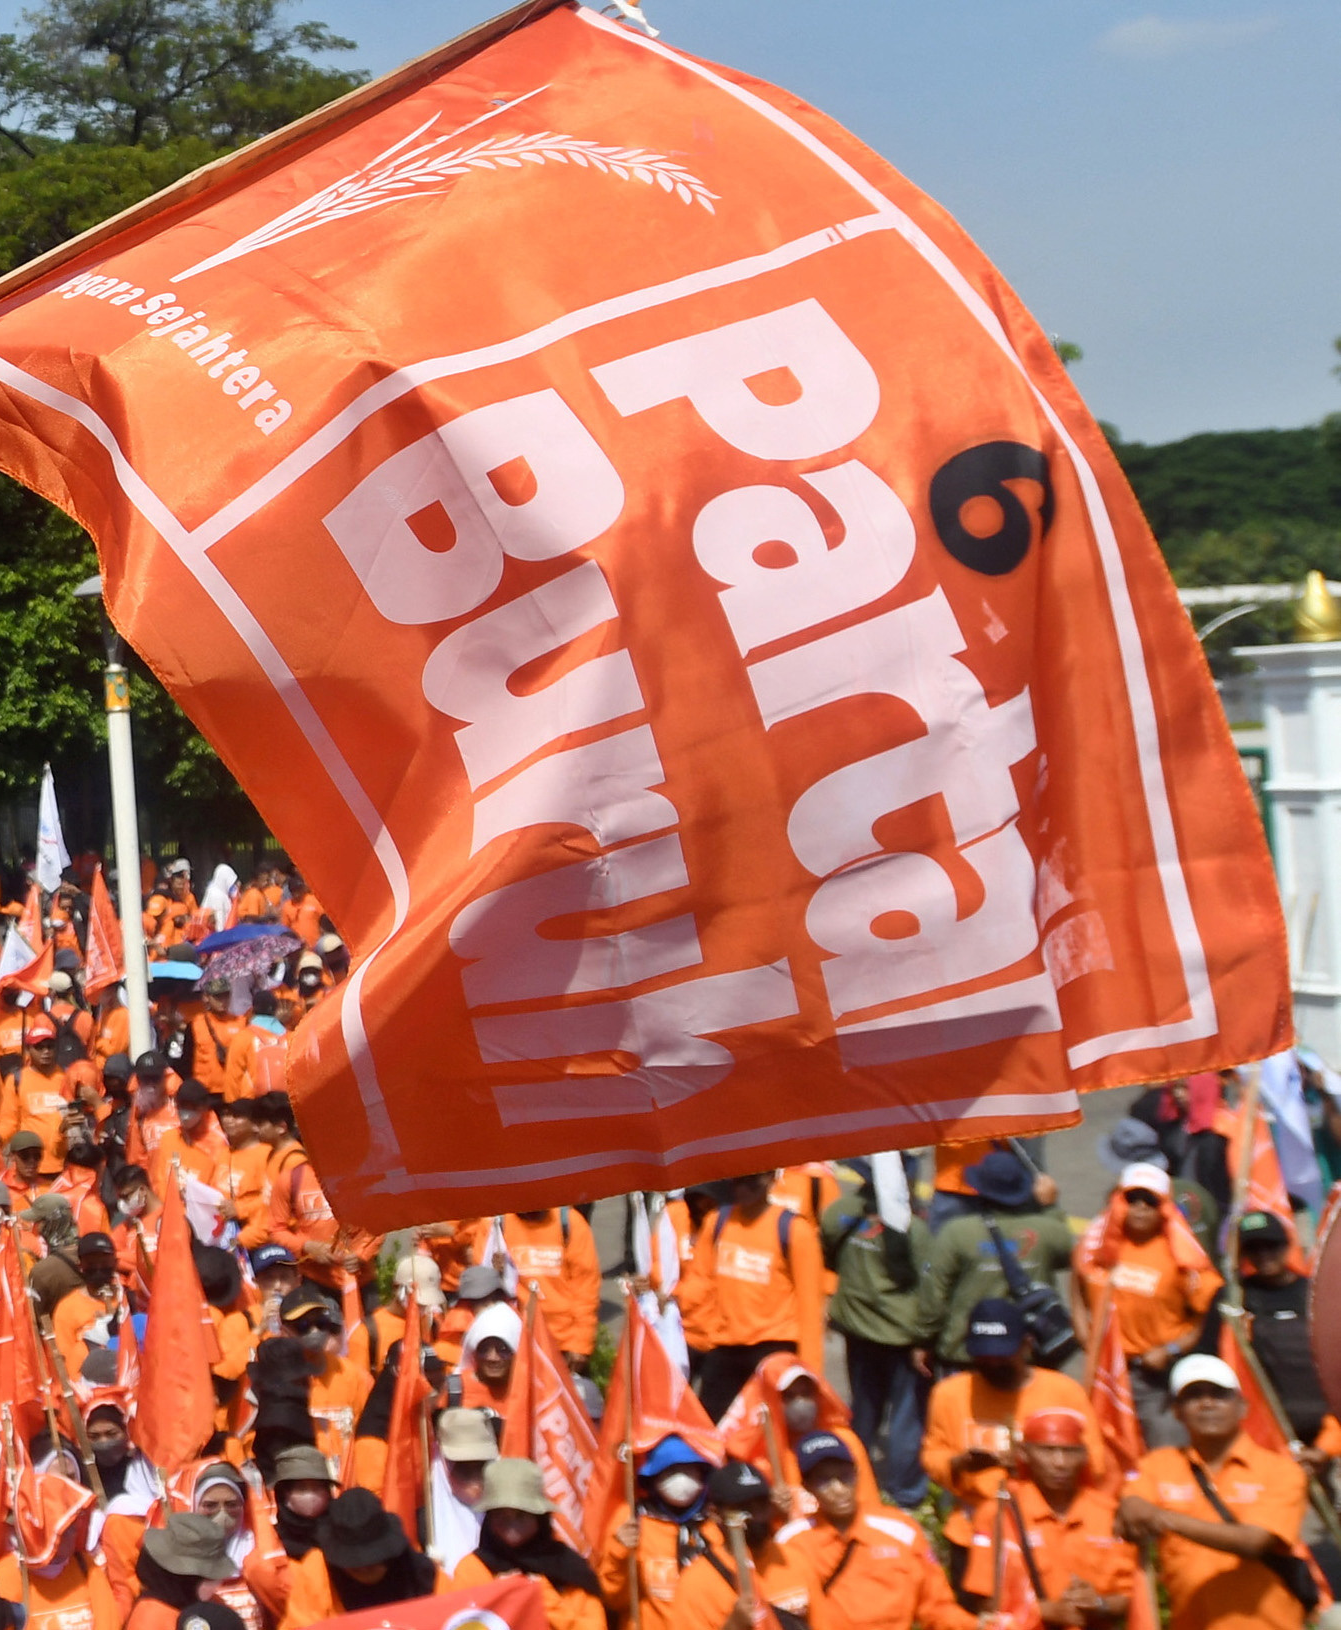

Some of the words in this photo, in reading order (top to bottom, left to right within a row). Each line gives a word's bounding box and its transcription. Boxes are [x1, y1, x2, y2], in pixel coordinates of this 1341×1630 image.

[129, 292, 293, 437] Sejahtera
[929, 440, 1056, 577] 6
[320, 387, 801, 1128] Buruh
[589, 296, 1114, 1074] Partai
